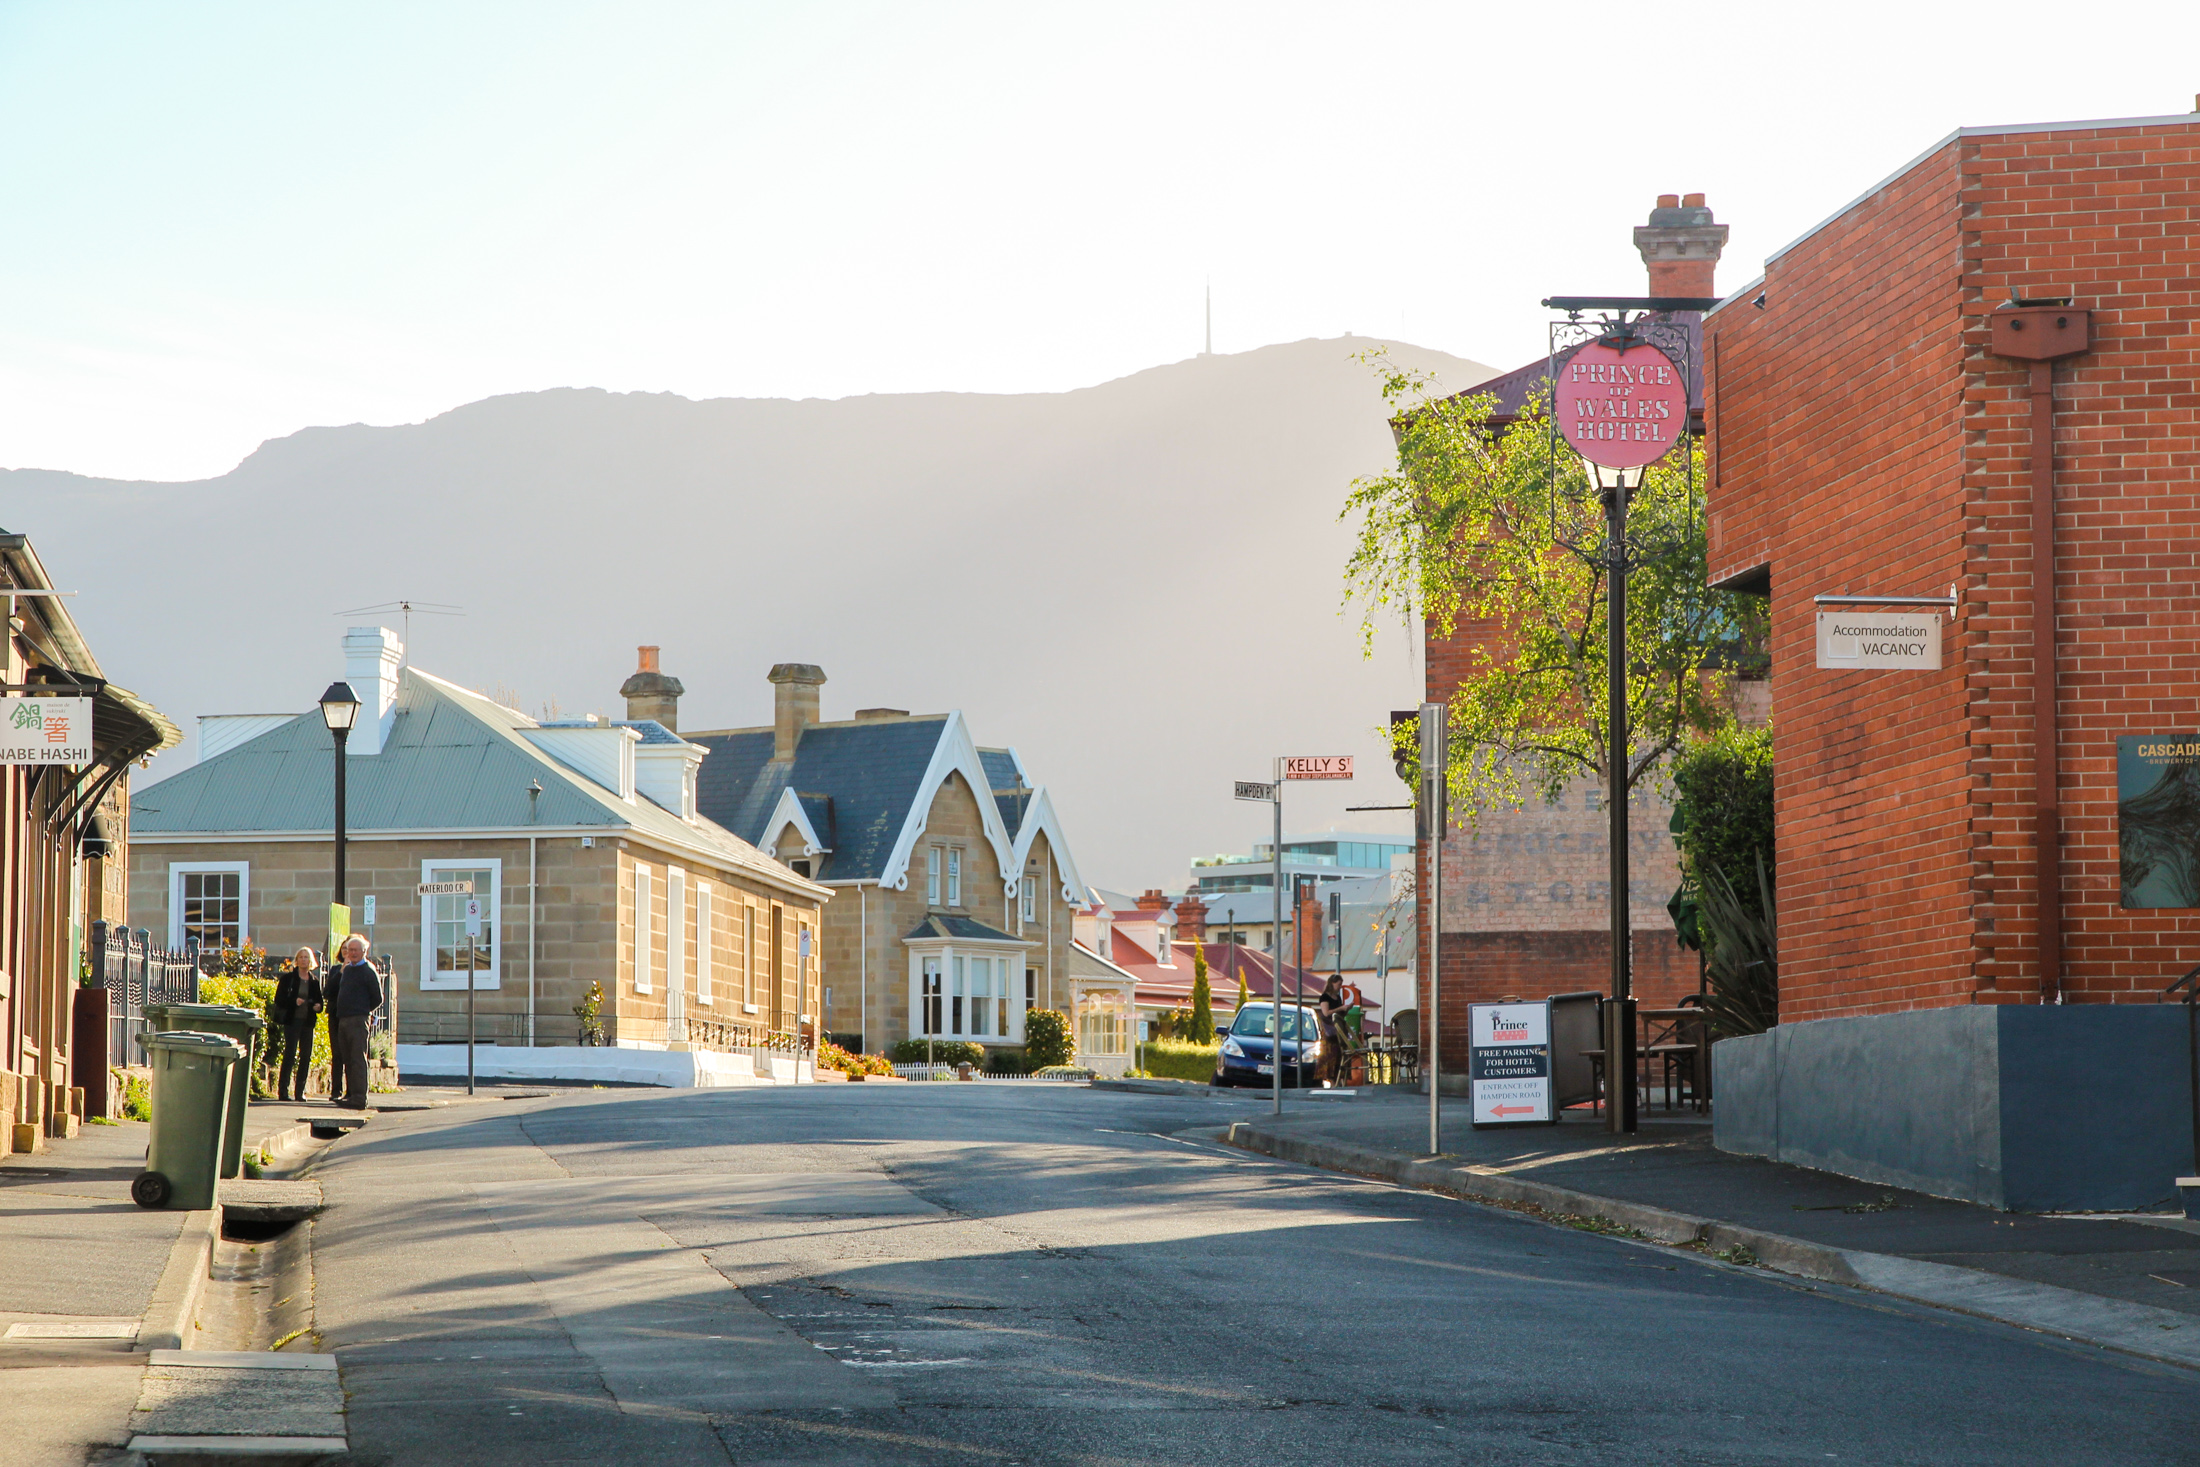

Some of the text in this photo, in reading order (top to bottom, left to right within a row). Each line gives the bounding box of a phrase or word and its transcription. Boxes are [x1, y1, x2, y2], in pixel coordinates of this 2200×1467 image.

[1571, 363, 1672, 385] PRINCE
[1609, 386, 1635, 397] OF
[1575, 398, 1670, 420] WALES
[1576, 421, 1667, 442] HOTEL
[1833, 625, 1927, 637] Accommodation
[1862, 643, 1926, 656] VACANCY
[41, 748, 87, 760] HASHI
[2138, 743, 2200, 757] CASCADE
[1288, 758, 1351, 772] KELLY ST
[1235, 783, 1264, 799] HAMPDEN
[1472, 832, 1664, 857] GROCEY
[419, 883, 464, 894] WATERLOO CR
[1493, 1019, 1528, 1031] Prince
[1478, 1048, 1541, 1058] FREE PARKING
[1484, 1067, 1537, 1076] CUSTOMERS
[1482, 1082, 1523, 1090] ENTRANCE
